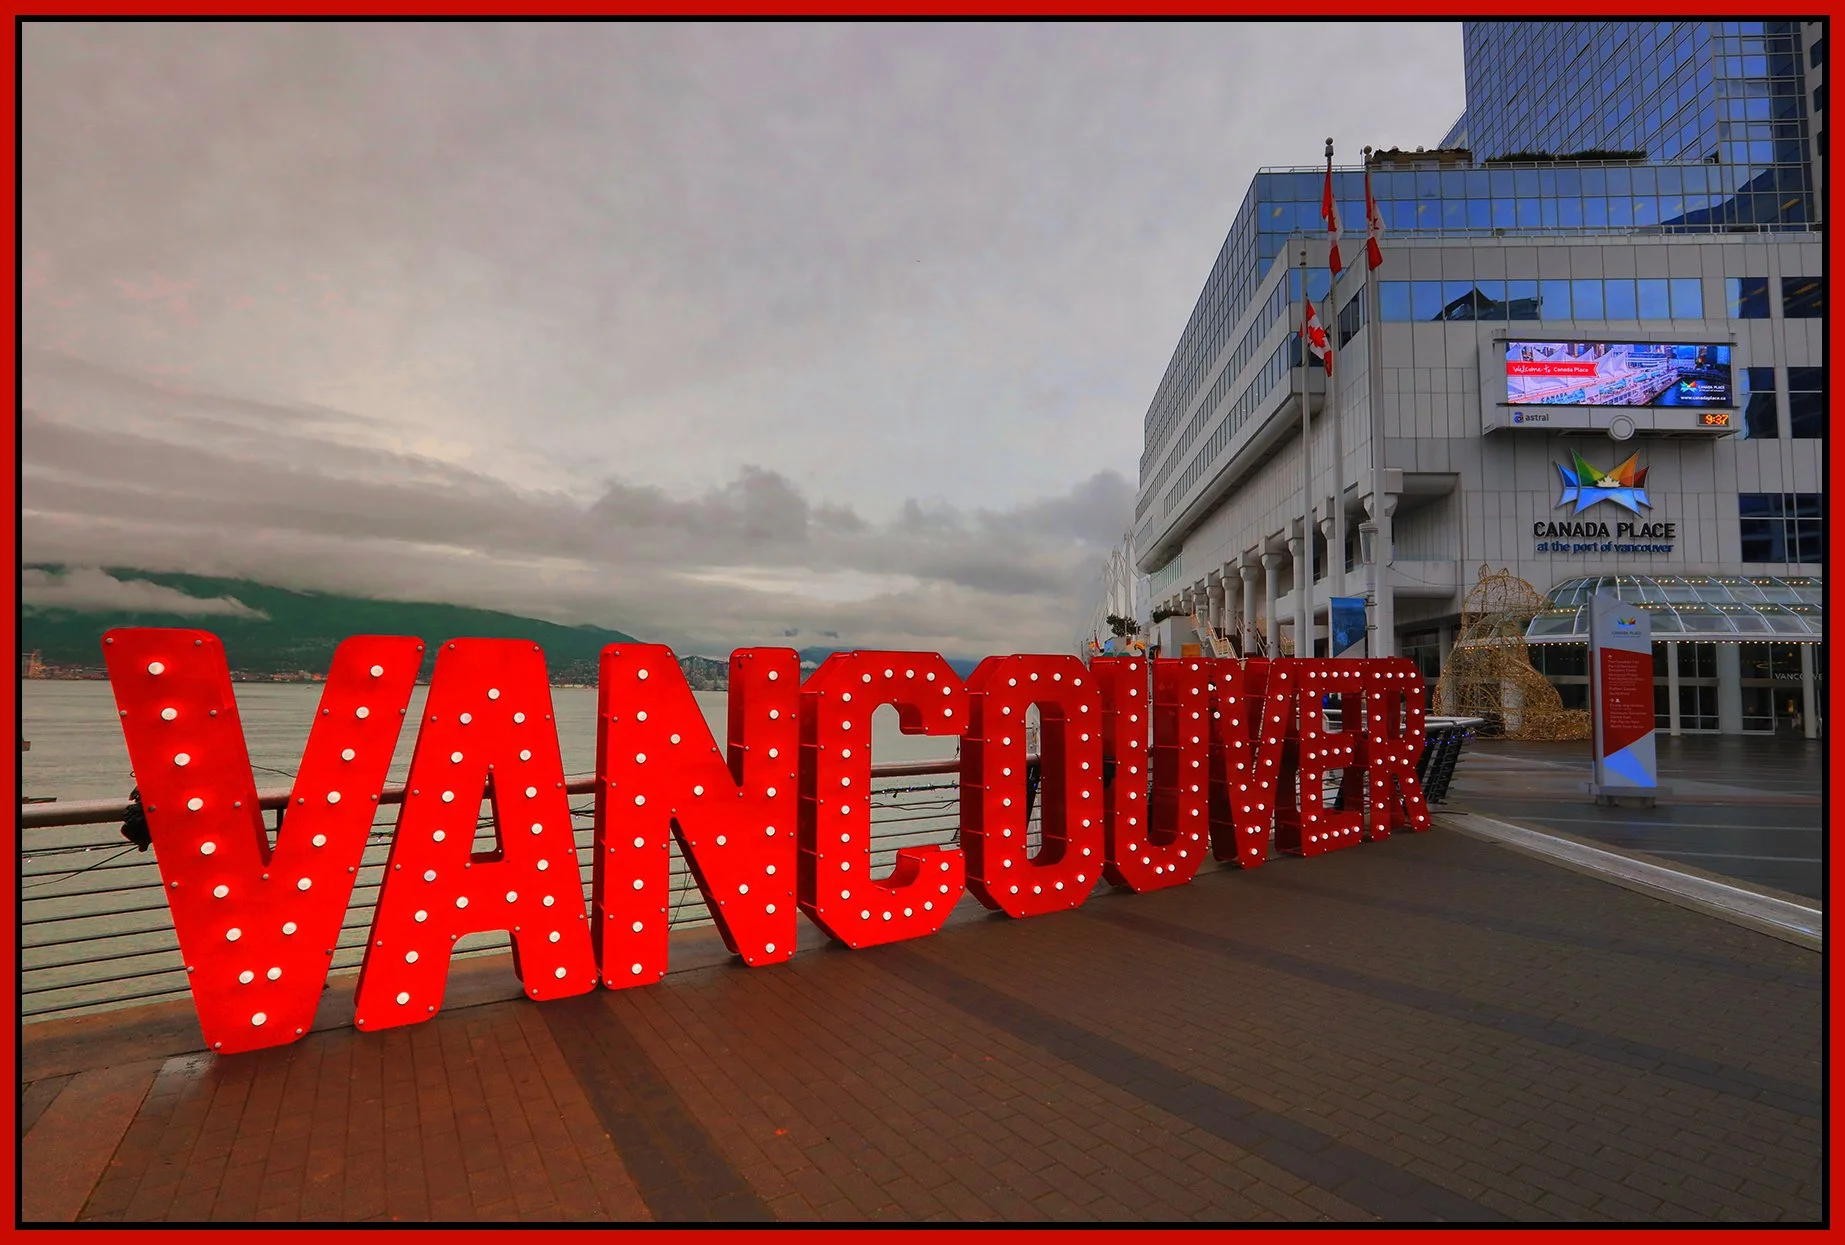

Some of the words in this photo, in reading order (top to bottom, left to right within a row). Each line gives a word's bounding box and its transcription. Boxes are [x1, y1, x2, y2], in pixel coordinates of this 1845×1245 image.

[1512, 364, 1542, 374] Welcome
[1543, 364, 1551, 373] to
[1525, 413, 1549, 422] astral
[1705, 414, 1729, 425] 9:37
[1533, 521, 1610, 539] CANADA
[1617, 522, 1676, 539] PLACE
[1537, 541, 1549, 552] at
[1551, 540, 1571, 552] the
[1573, 542, 1598, 554] port
[1600, 541, 1613, 552] of
[1614, 542, 1675, 553] vancouver
[102, 627, 1431, 1054] VANCOUVER
